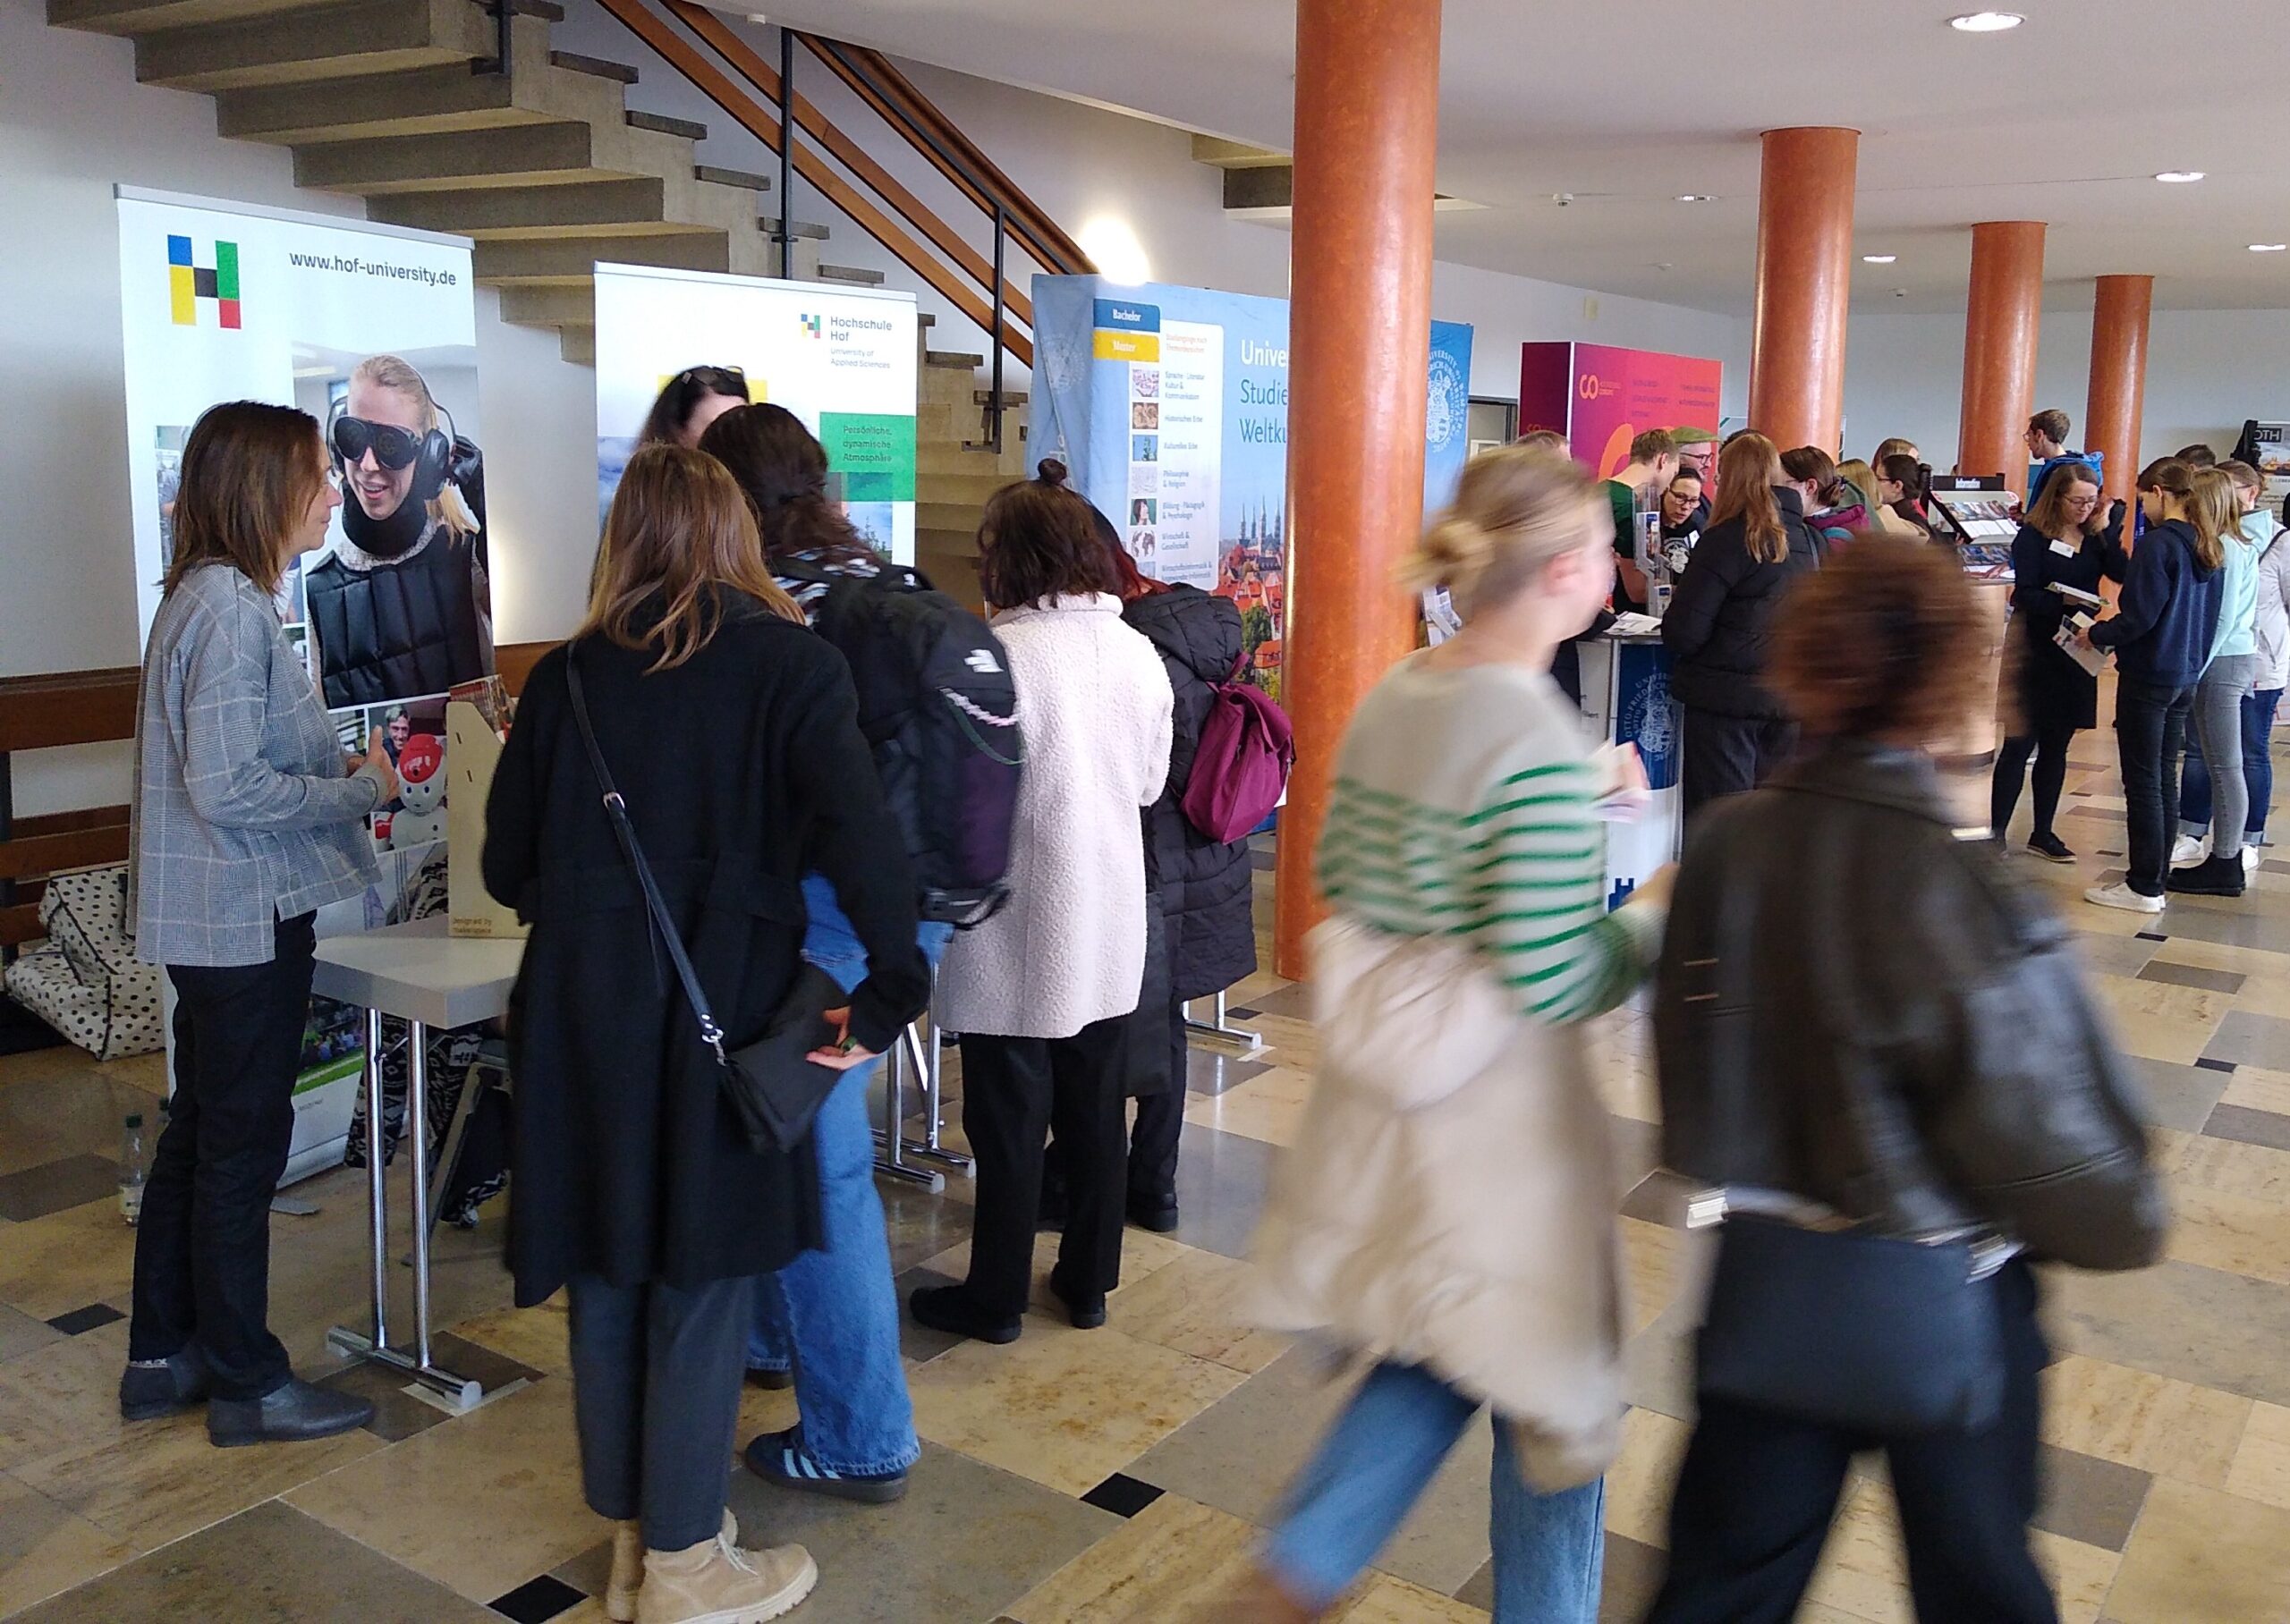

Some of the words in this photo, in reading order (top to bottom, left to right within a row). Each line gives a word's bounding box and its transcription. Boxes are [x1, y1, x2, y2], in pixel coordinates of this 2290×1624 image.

[289, 251, 457, 286] www.hof-university.de
[1112, 309, 1141, 322] Bachelor
[830, 316, 893, 331] Hochschule
[830, 331, 849, 342] Hof
[1113, 341, 1136, 351] Master
[831, 348, 865, 358] University
[830, 359, 858, 368] Applied
[859, 359, 891, 369] Sciences
[843, 439, 891, 450] dynamische
[844, 452, 893, 463] Atmosphäre
